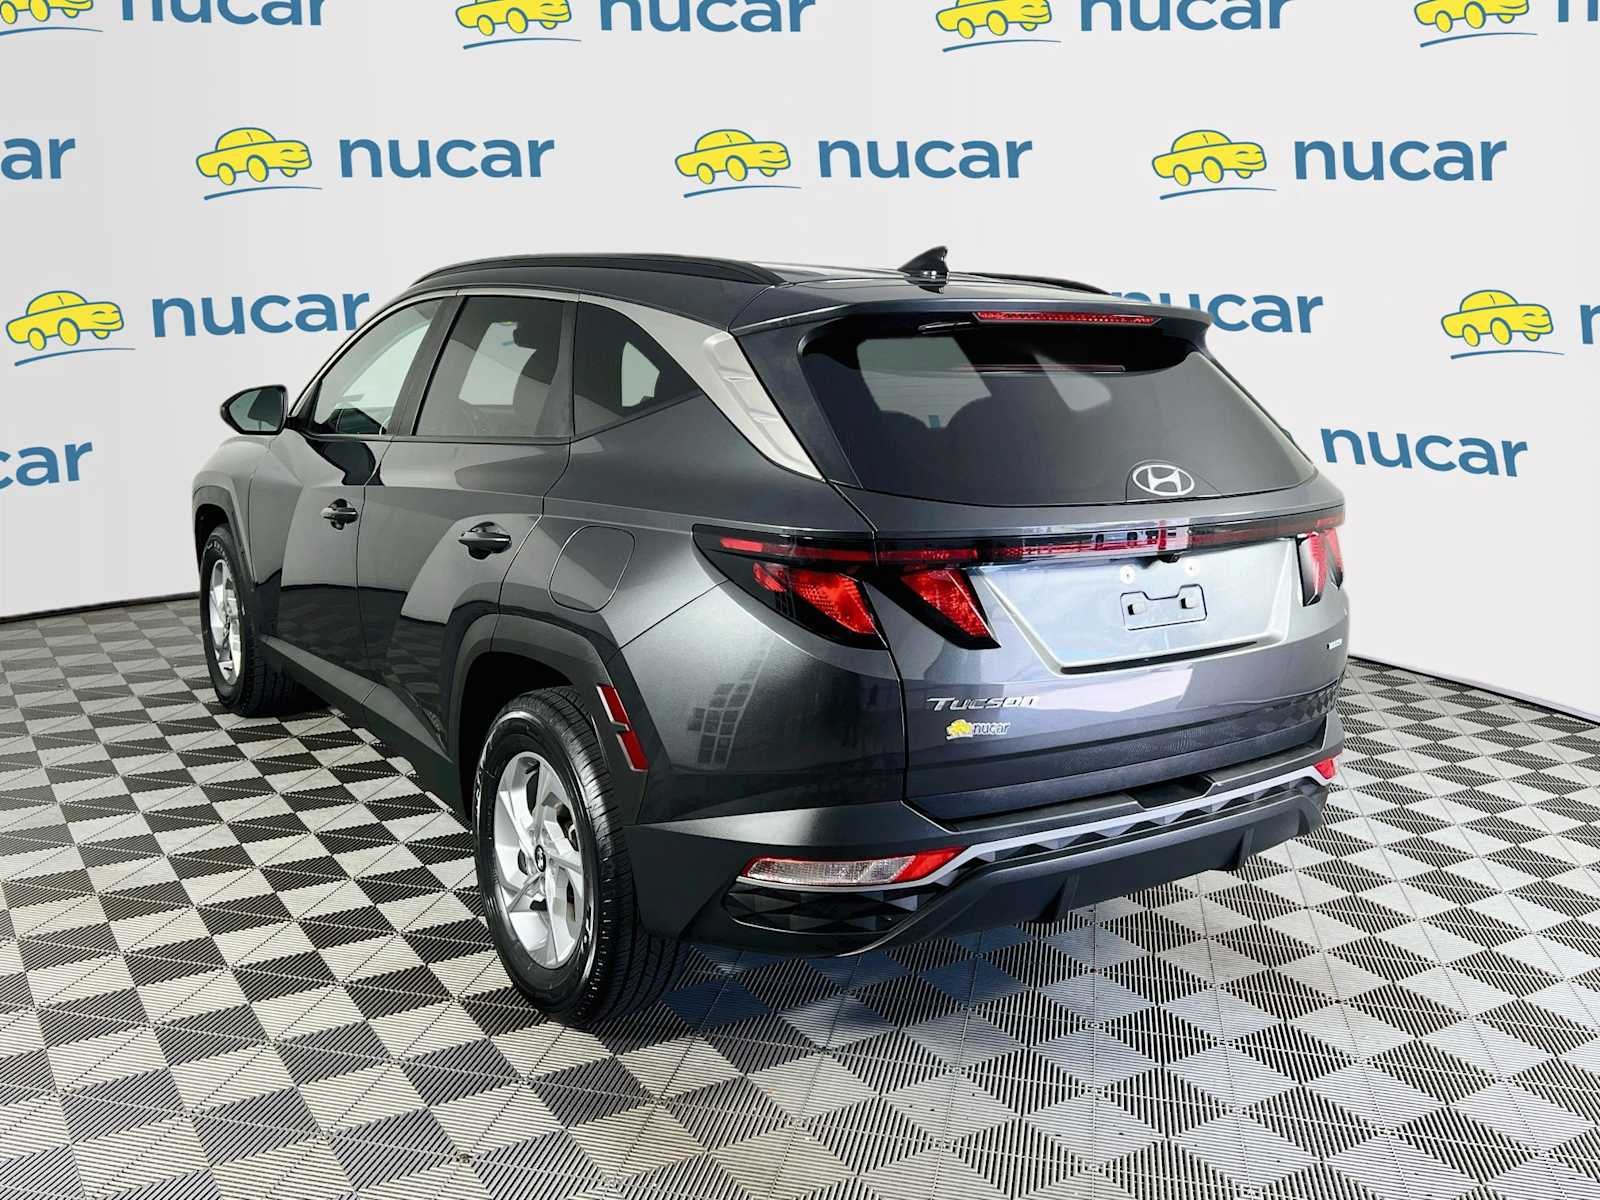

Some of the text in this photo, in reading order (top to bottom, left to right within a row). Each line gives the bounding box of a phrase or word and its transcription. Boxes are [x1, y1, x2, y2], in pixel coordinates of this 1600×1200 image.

[600, 0, 816, 32] nucar
[1081, 0, 1291, 31] nucar
[339, 138, 554, 178] nucar
[819, 140, 1032, 179] nucar
[1294, 140, 1507, 181] nucar
[152, 292, 370, 337] nucar
[1320, 428, 1528, 477] nucar
[973, 722, 1010, 735] nucar
